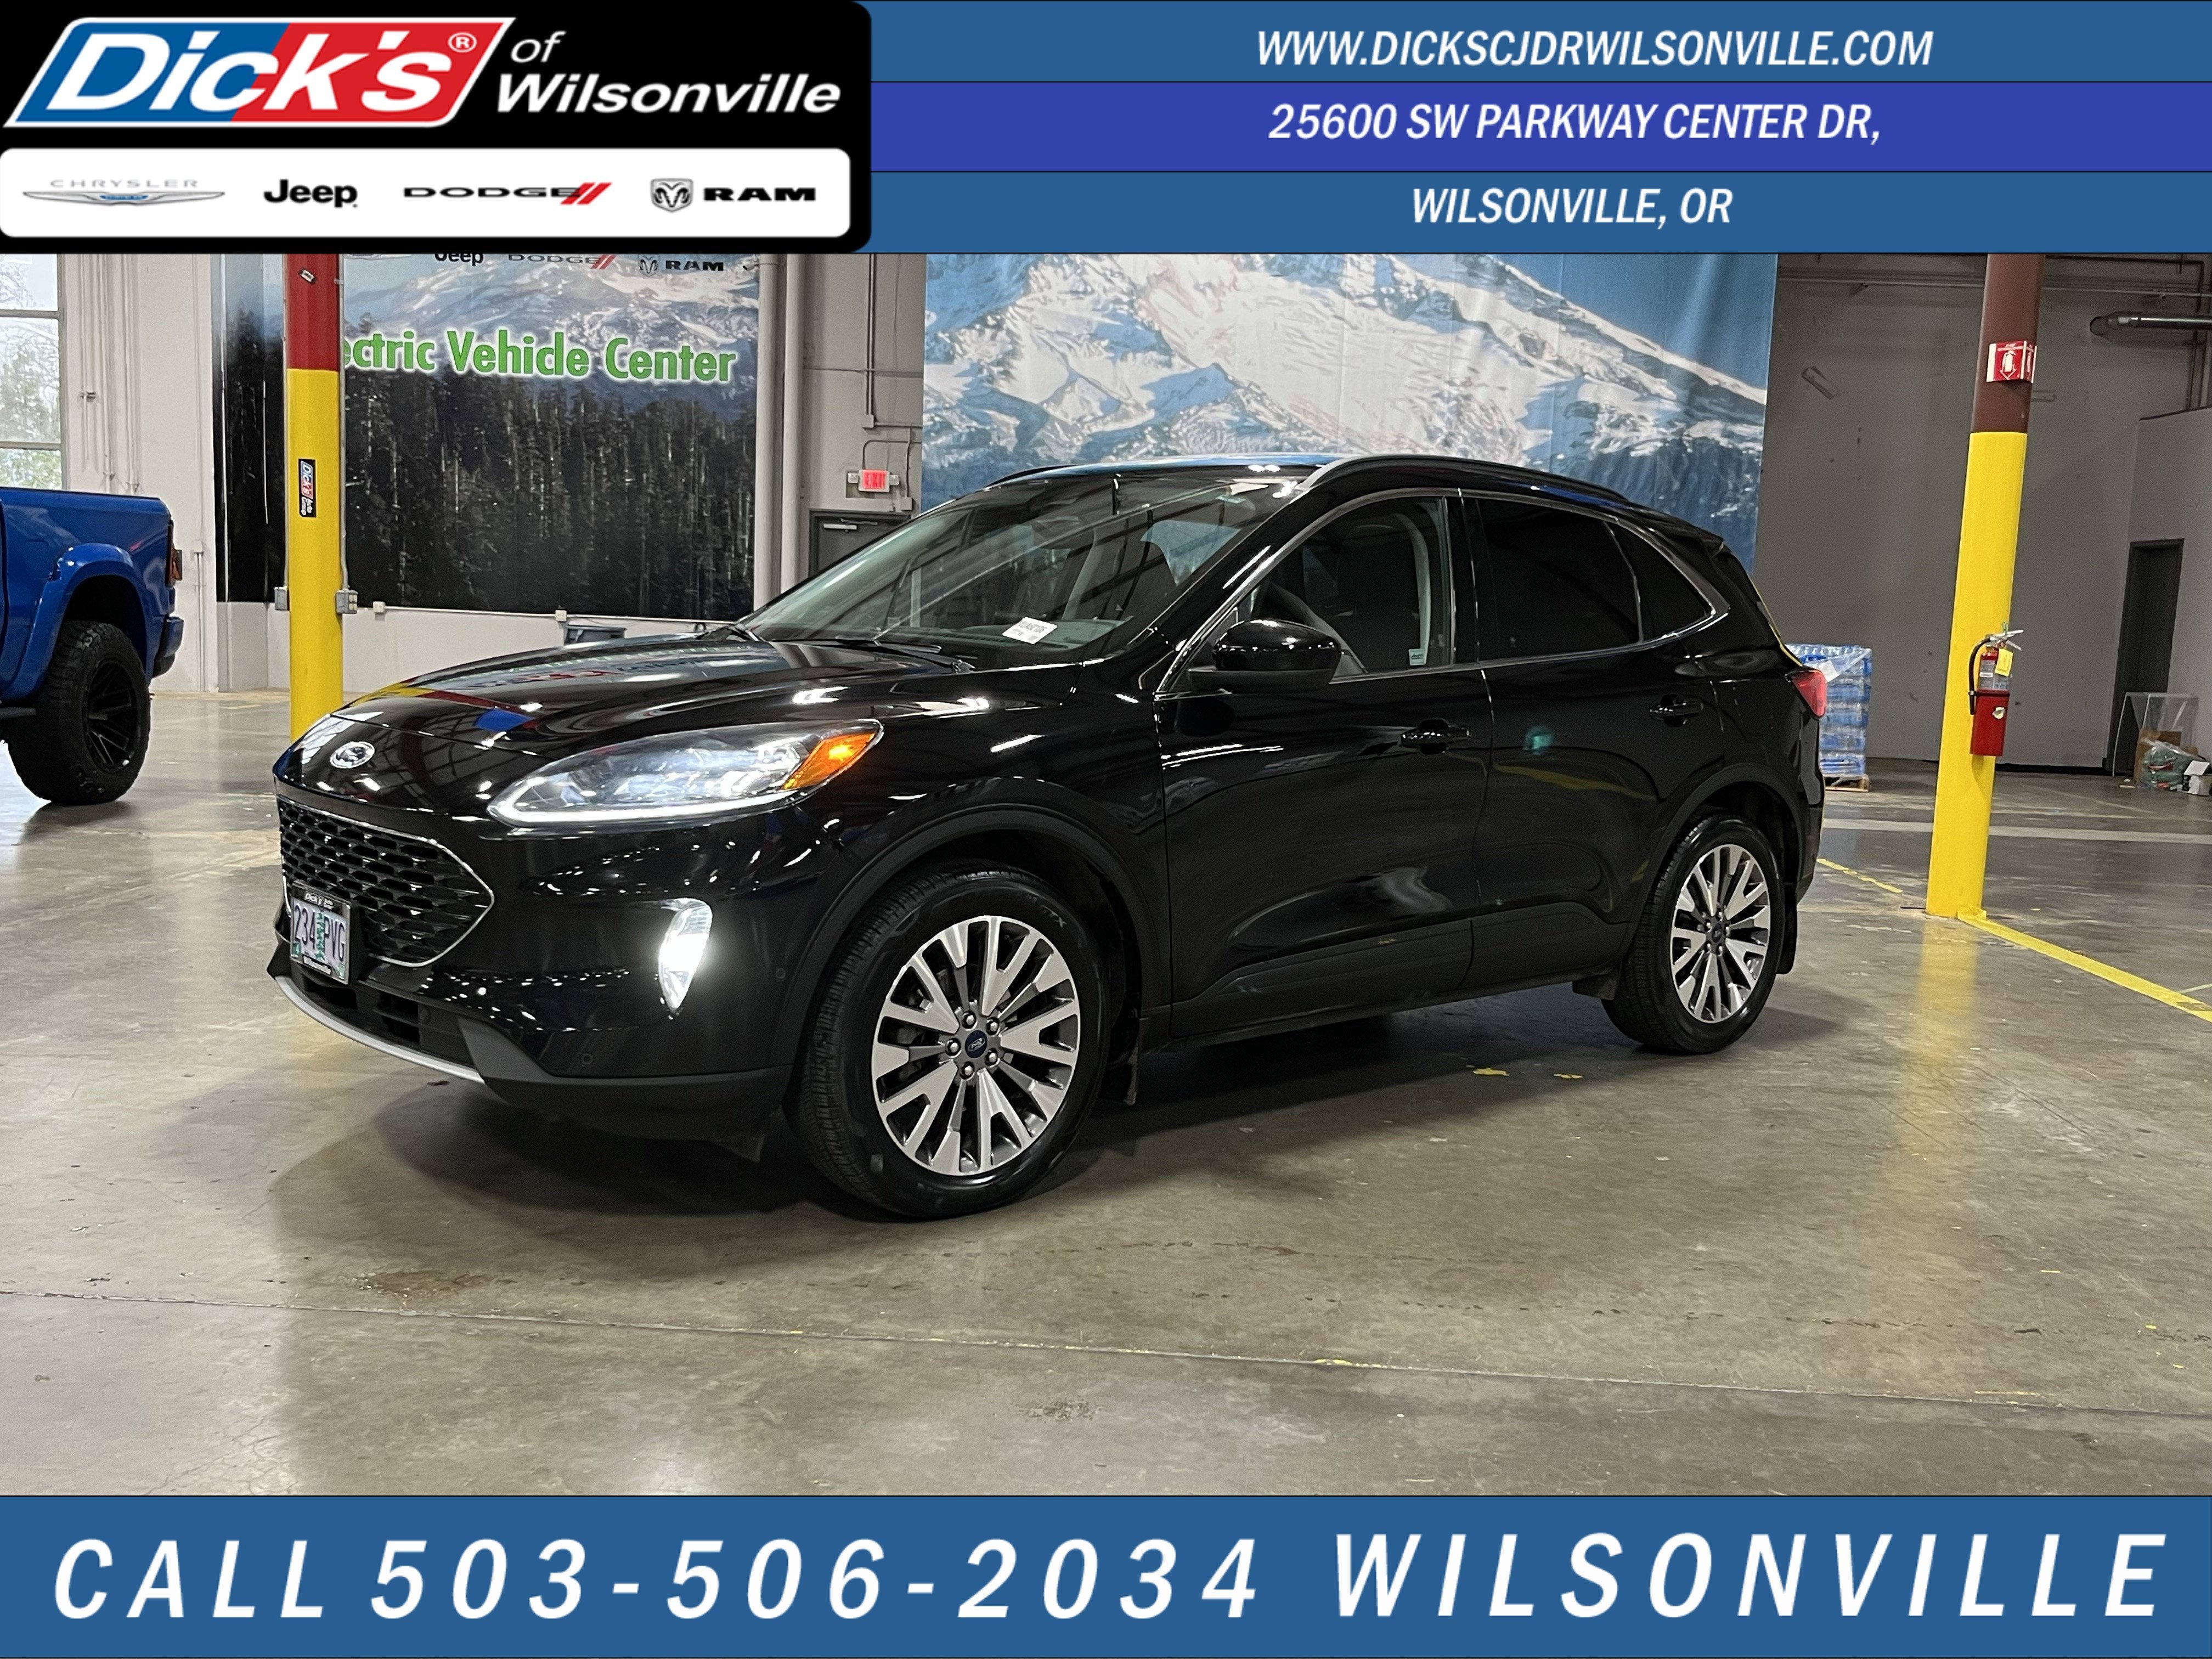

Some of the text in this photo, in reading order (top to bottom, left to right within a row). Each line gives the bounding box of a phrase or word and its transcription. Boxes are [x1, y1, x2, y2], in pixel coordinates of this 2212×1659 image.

[666, 260, 724, 271] RAM
[447, 330, 589, 377] Vehicle
[606, 337, 736, 381] Center
[295, 905, 346, 962] 234 PVG
